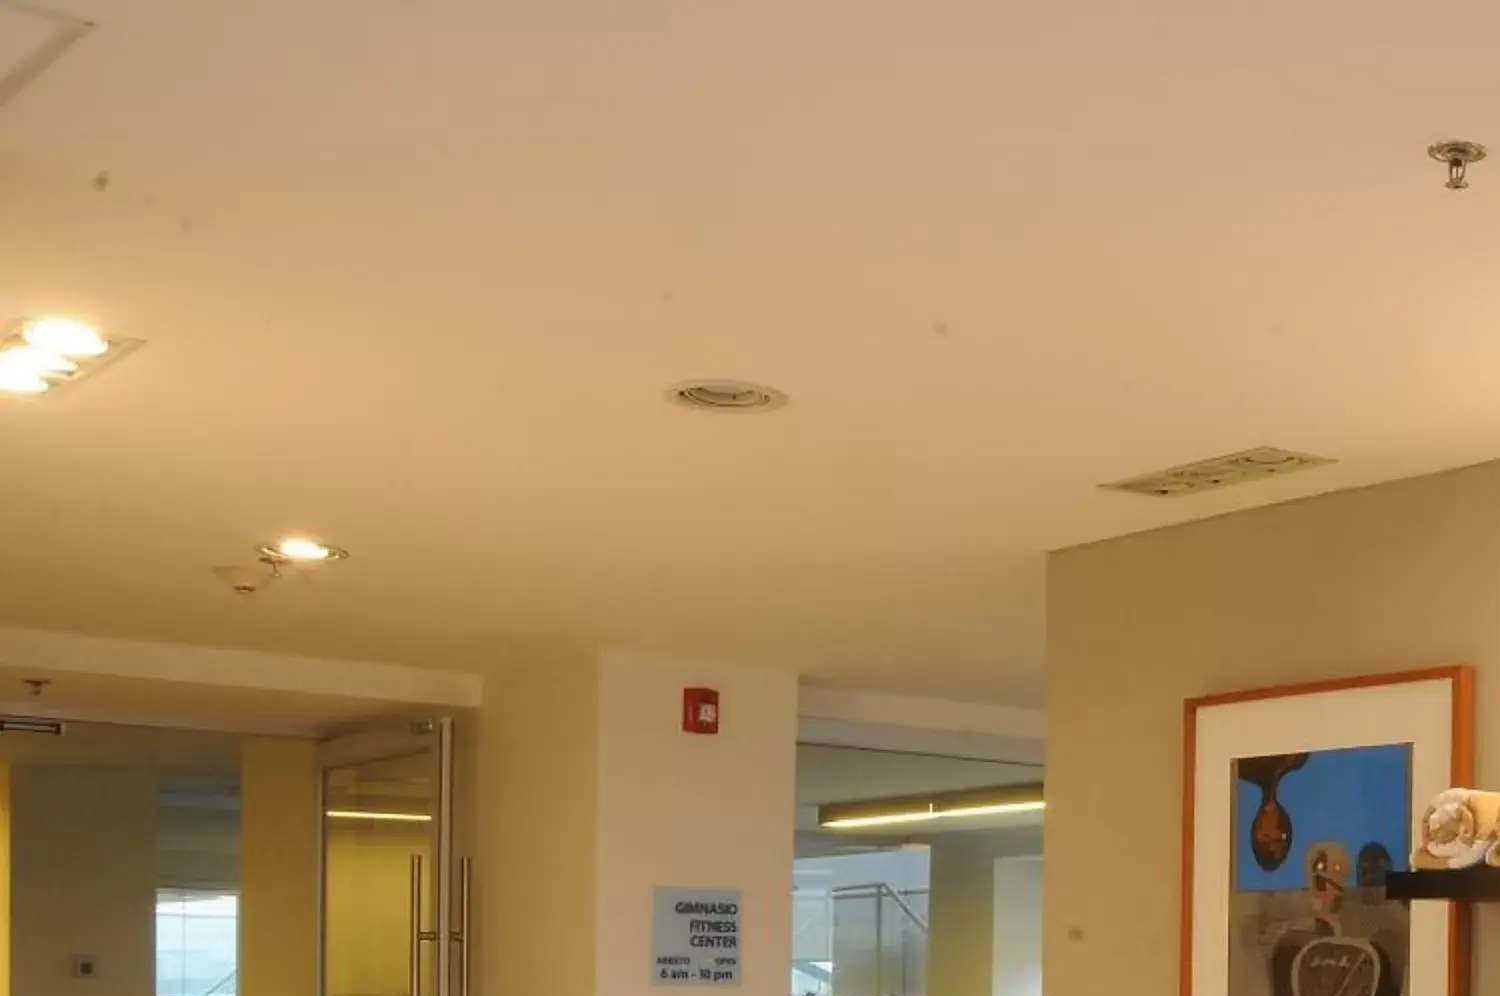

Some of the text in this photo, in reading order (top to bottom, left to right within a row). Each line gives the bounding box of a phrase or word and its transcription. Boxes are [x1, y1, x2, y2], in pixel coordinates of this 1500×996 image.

[689, 919, 737, 933] FITNESS
[689, 935, 737, 948] CENTER
[699, 968, 711, 980] 10
[713, 970, 733, 982] pm
